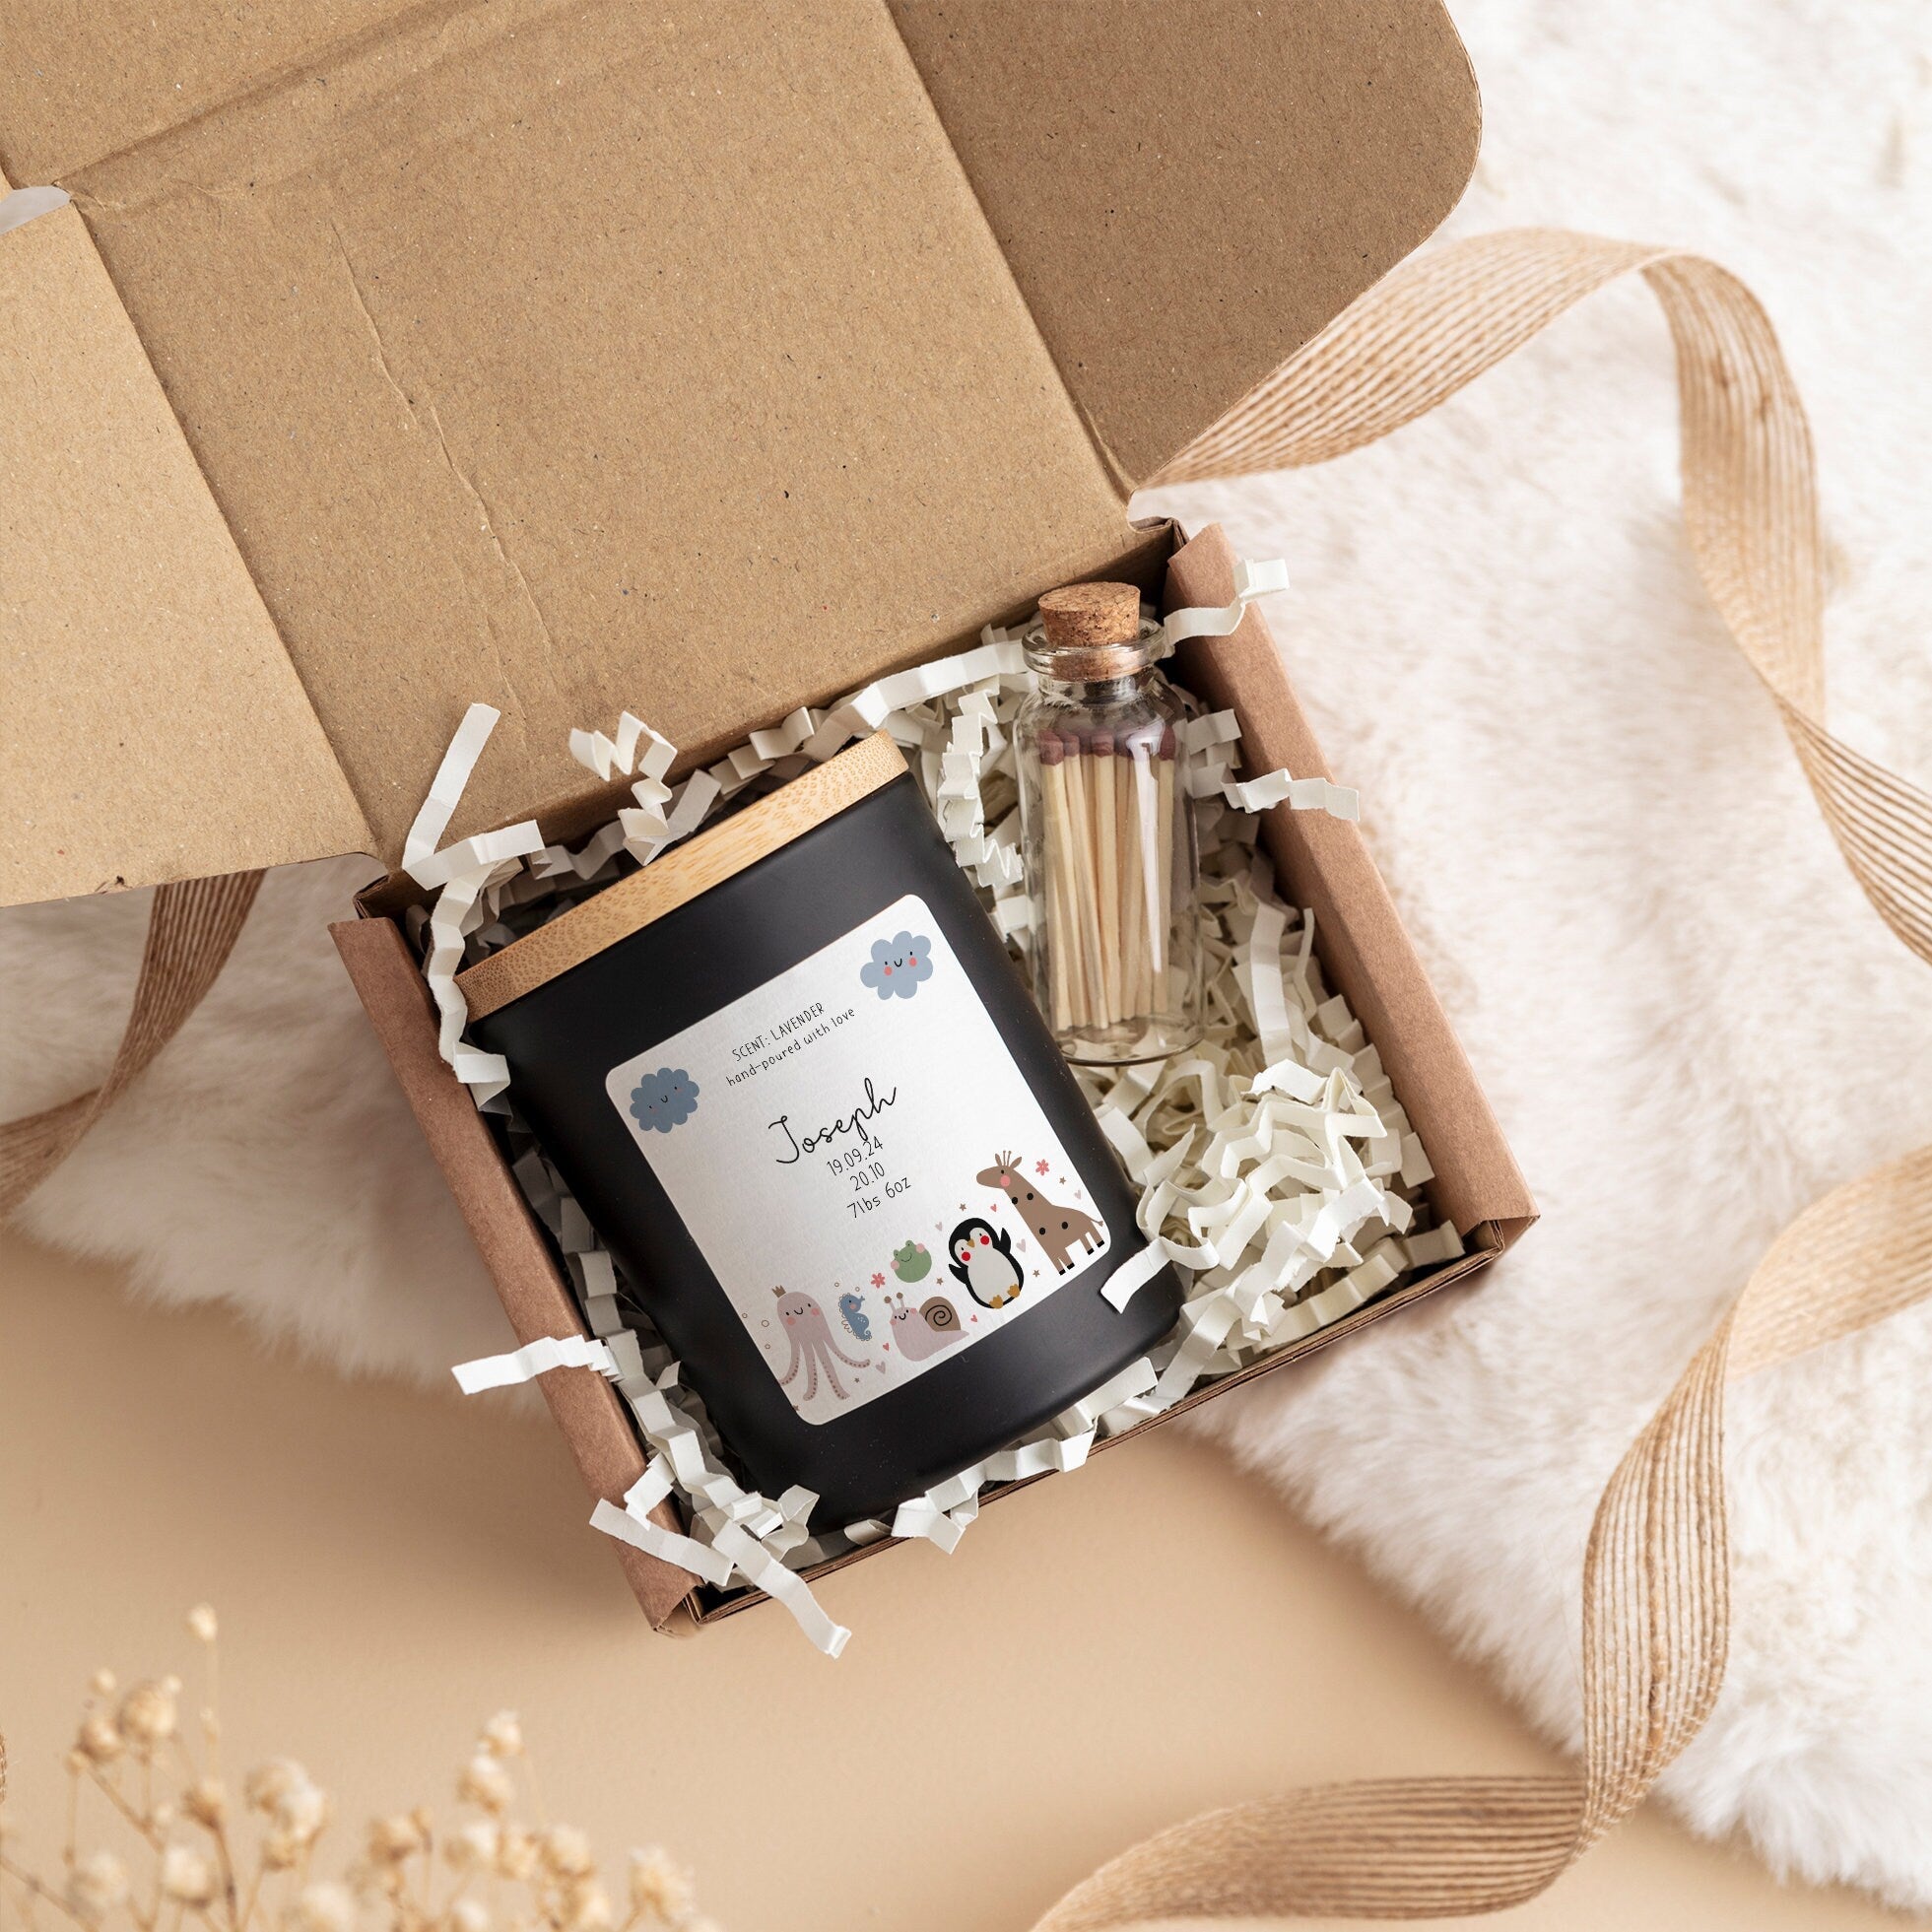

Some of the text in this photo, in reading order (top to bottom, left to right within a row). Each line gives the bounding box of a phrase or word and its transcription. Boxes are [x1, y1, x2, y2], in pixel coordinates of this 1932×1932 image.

[726, 1008, 855, 1087] hand-poured with love
[732, 1002, 825, 1062] SCENT: LAVENDER
[767, 1077, 897, 1165] Joseph
[827, 1135, 884, 1176] 19.09.24
[849, 1162, 885, 1192] 20.10
[846, 1176, 911, 1219] 7lbs 6oz
